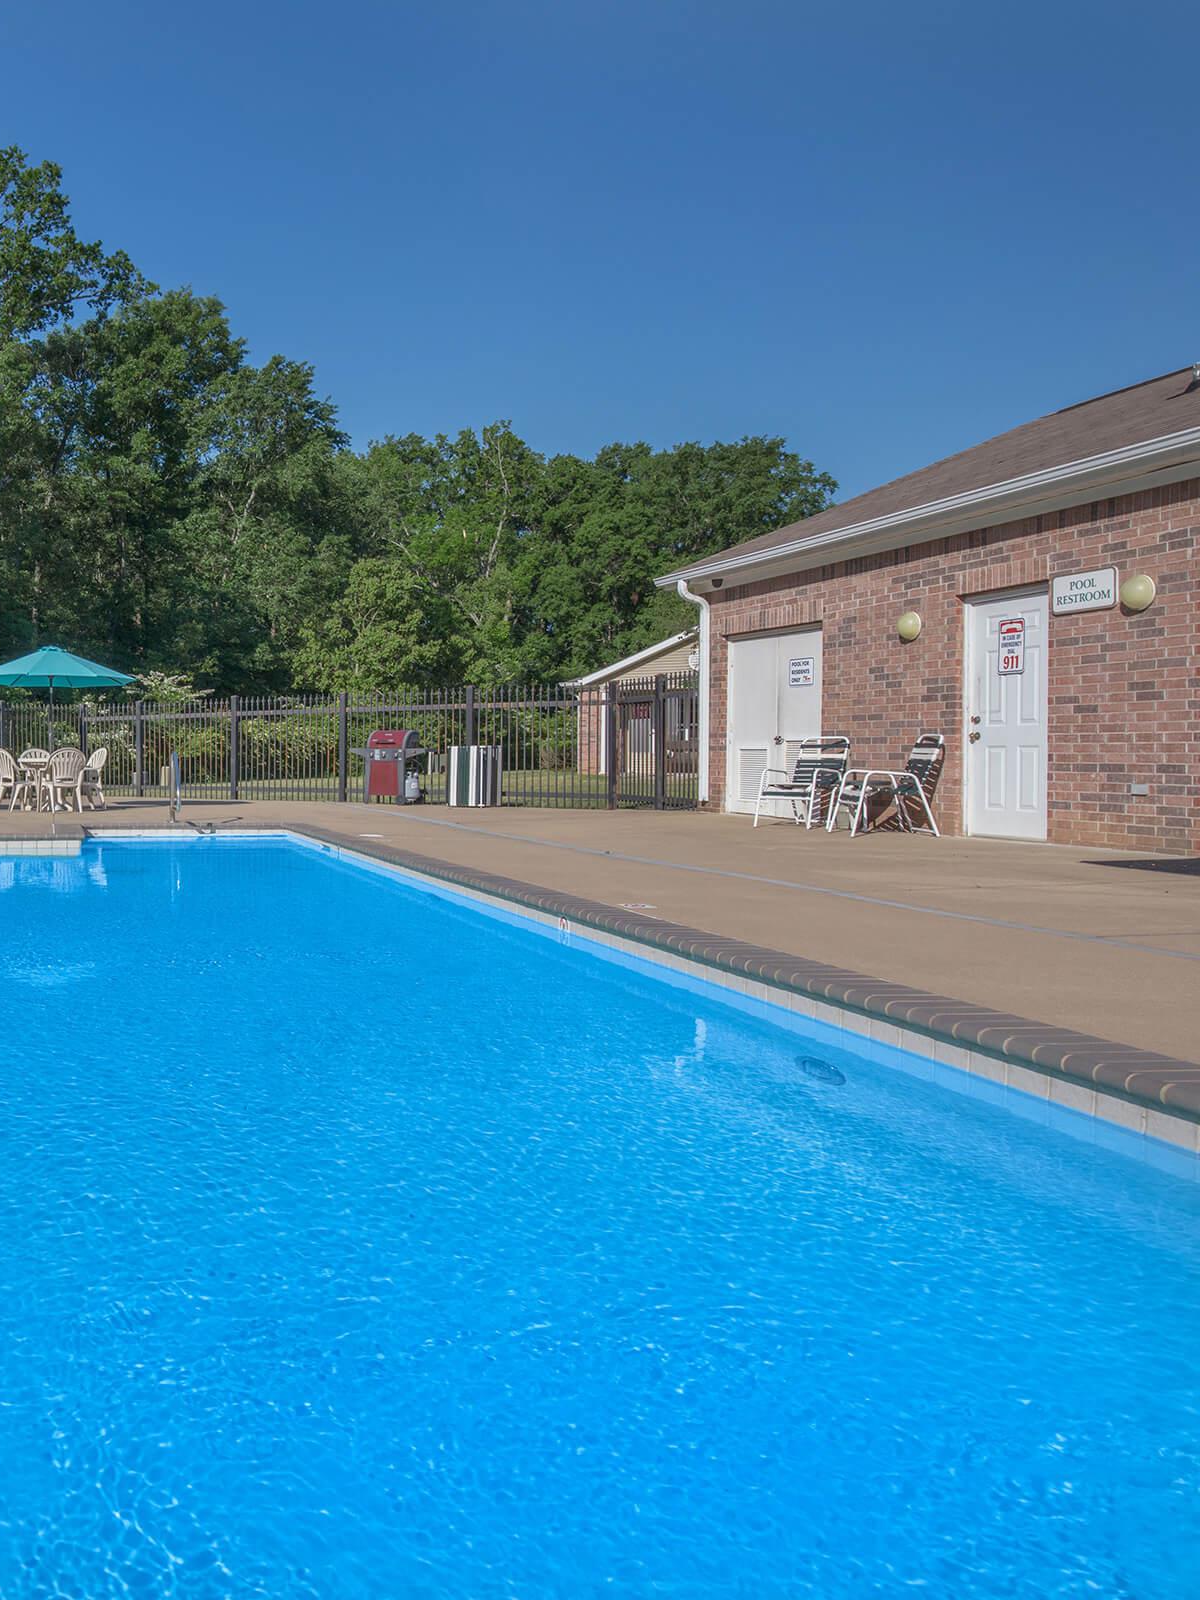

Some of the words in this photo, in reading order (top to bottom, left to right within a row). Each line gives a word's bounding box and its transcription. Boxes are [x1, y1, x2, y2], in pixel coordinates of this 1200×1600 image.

[1070, 578, 1096, 590] POOL
[1056, 589, 1111, 606] RESTROOM
[1003, 655, 1019, 670] 911
